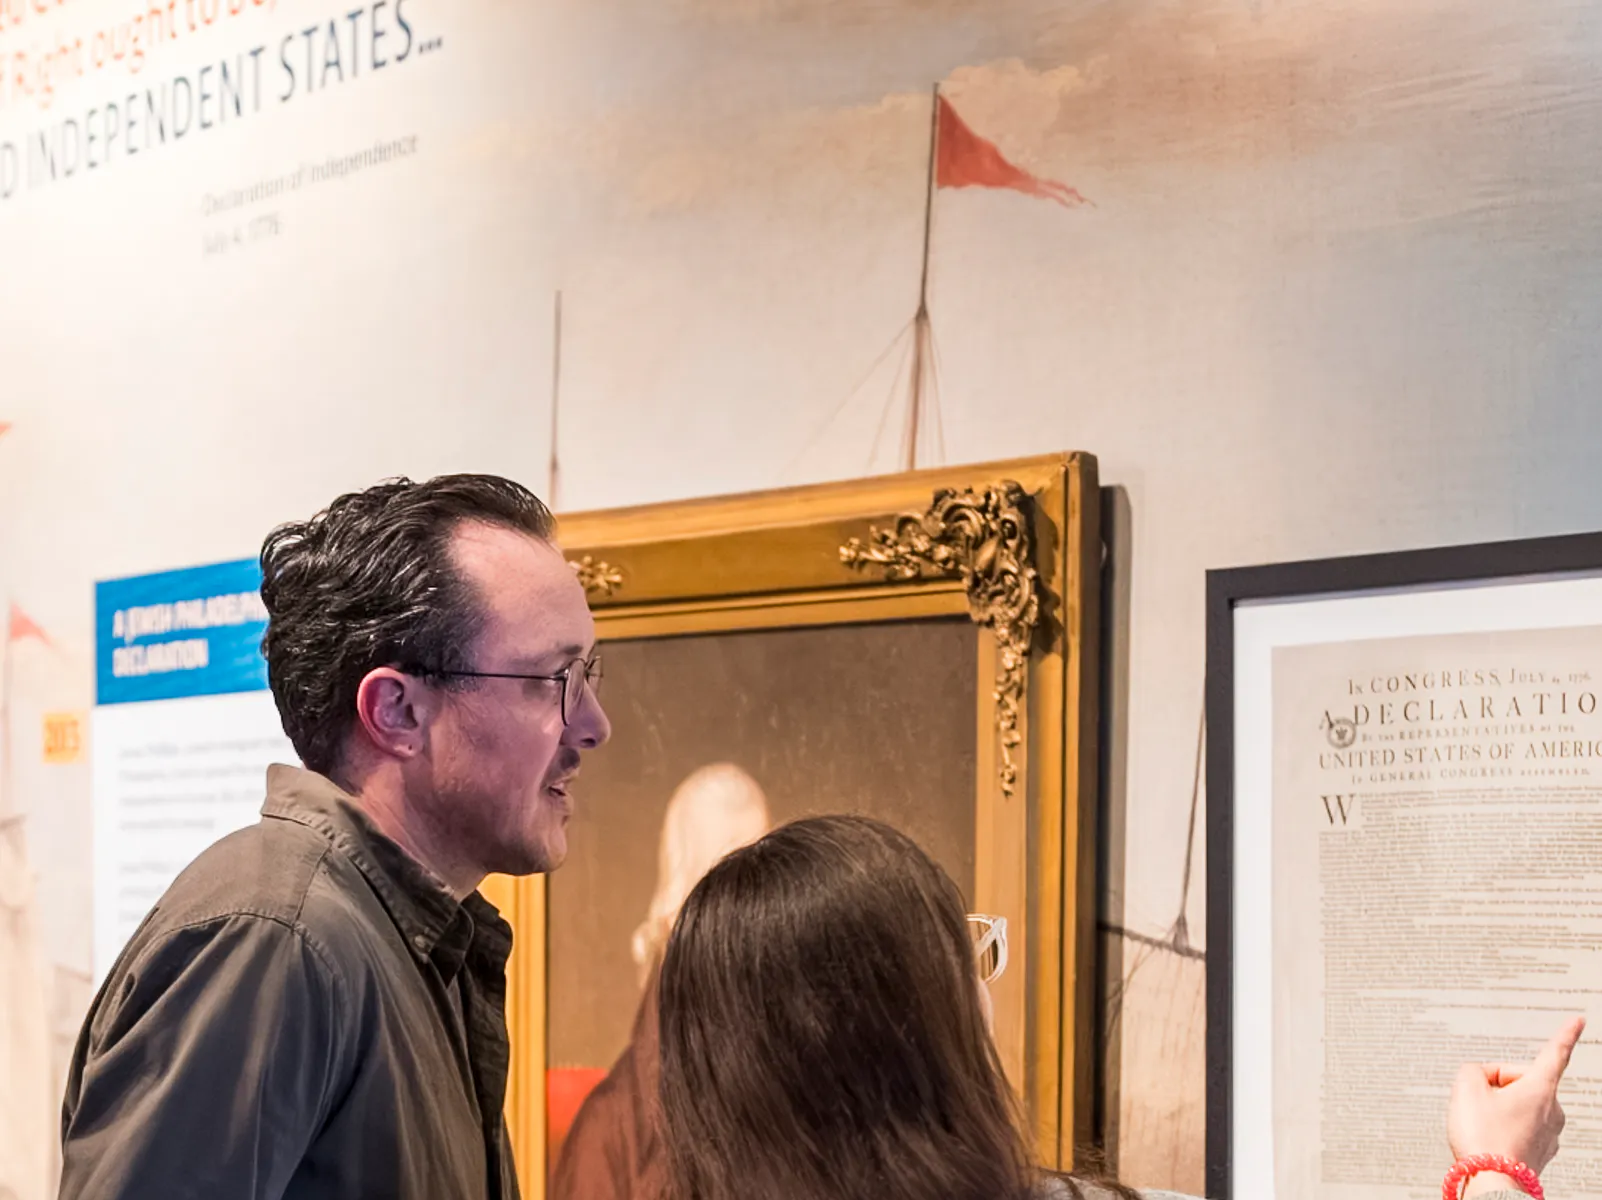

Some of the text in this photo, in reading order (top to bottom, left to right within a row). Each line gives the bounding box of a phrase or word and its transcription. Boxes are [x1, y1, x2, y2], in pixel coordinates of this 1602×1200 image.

[26, 46, 266, 191] INDEPENDENT
[278, 0, 443, 103] STATES...
[1353, 691, 1597, 725] DECLARATIO
[1318, 747, 1396, 770] UNITED
[1404, 743, 1482, 764] STATES
[1488, 741, 1515, 761] OF
